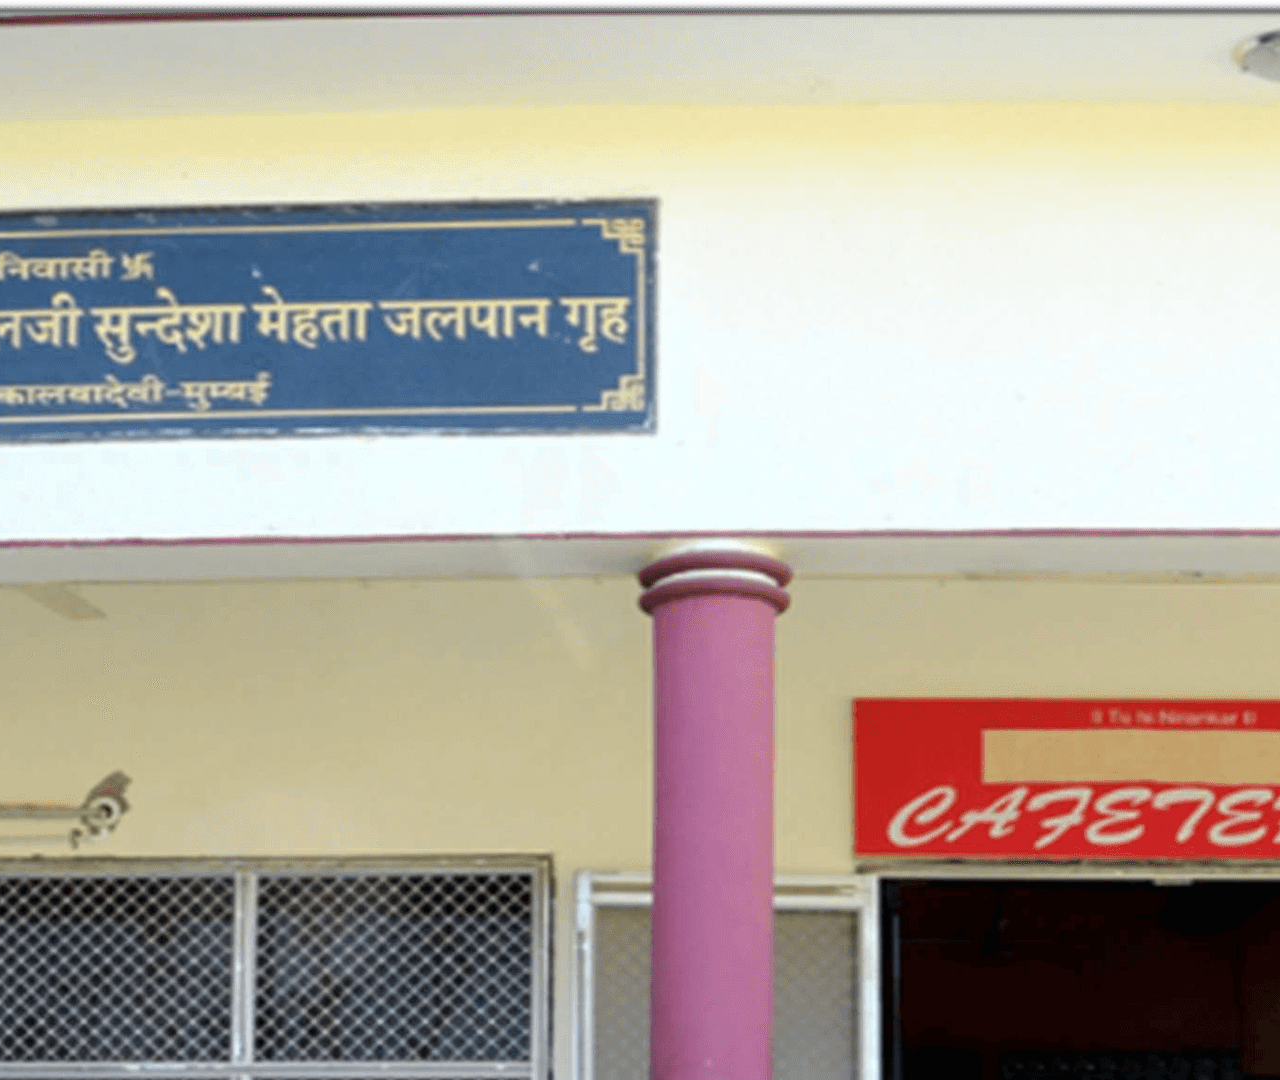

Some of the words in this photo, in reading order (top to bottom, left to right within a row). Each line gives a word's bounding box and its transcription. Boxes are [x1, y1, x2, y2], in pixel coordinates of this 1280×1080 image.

[90, 287, 245, 364] सुन्देशा
[252, 285, 372, 350] मेहता
[379, 298, 552, 342] जलपान
[560, 296, 631, 353] गृह
